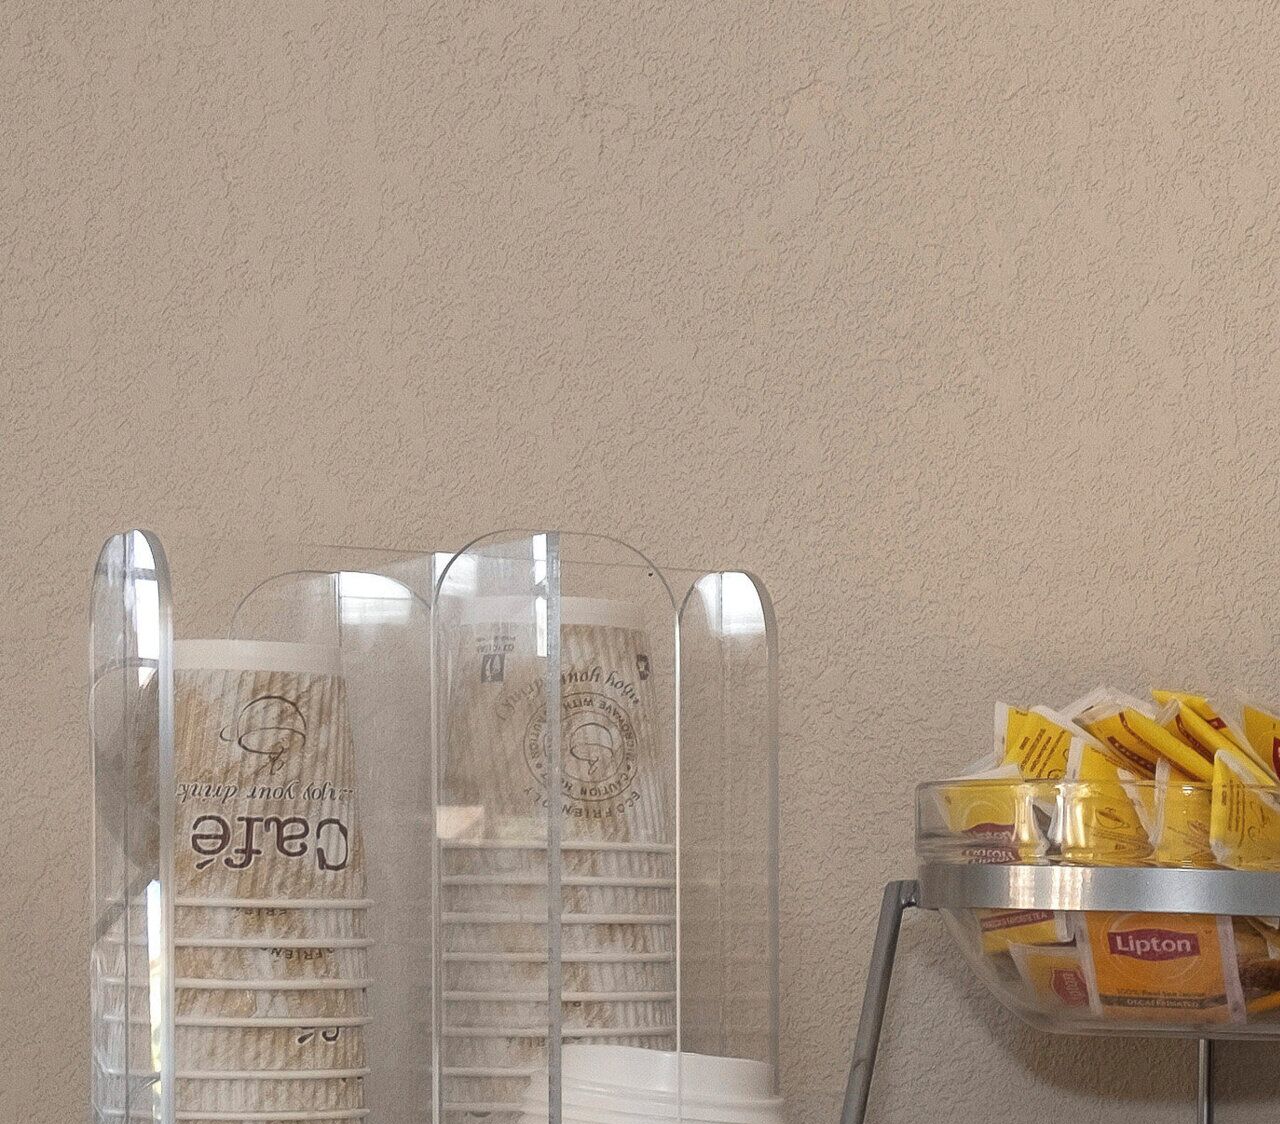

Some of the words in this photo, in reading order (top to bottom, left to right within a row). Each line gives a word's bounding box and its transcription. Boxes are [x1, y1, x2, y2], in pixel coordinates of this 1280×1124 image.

[176, 782, 240, 805] drink
[246, 781, 300, 803] your
[616, 790, 640, 813] ECO
[191, 814, 349, 871] Café
[1115, 934, 1192, 956] Lipton
